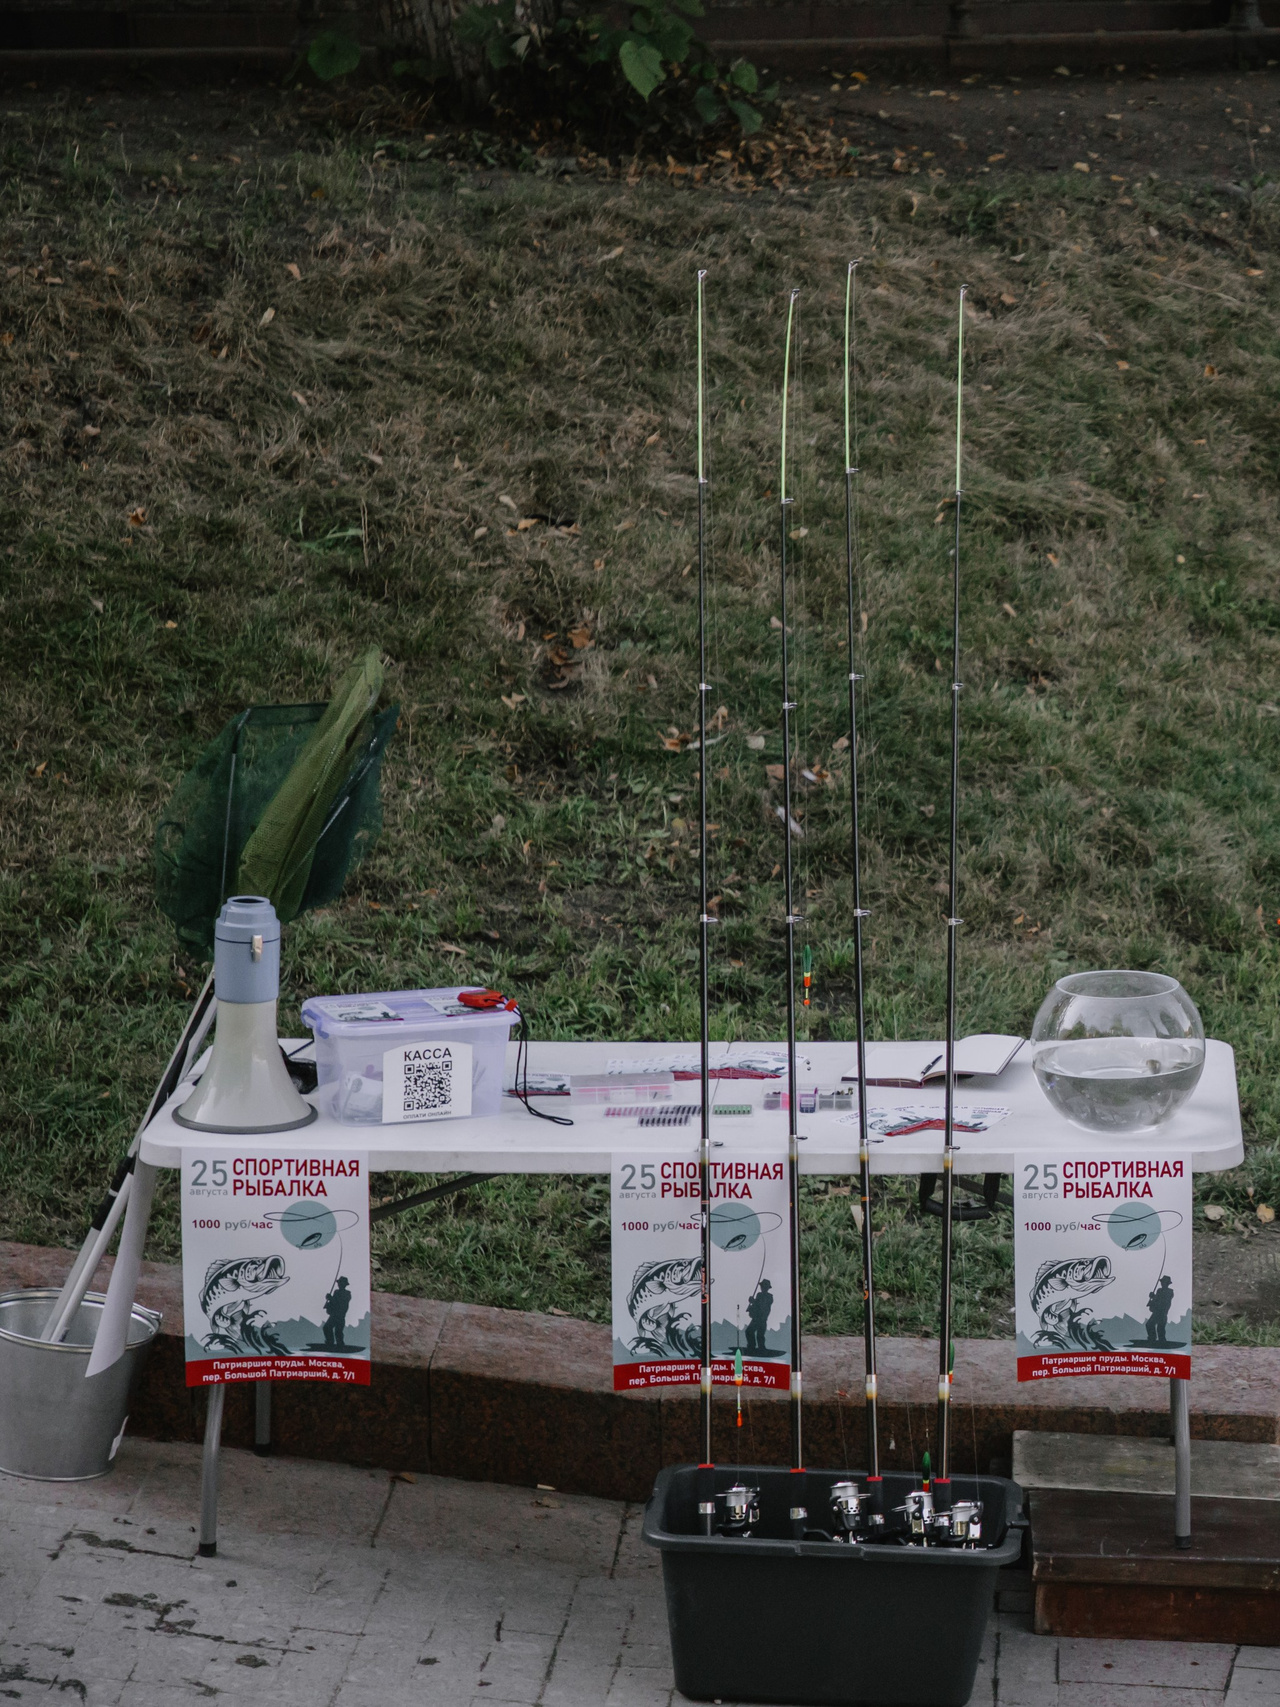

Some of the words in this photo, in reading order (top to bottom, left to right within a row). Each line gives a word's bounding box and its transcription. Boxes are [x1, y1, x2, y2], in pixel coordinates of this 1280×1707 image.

[404, 1047, 452, 1061] КАССА
[191, 1160, 228, 1186] 25
[232, 1158, 359, 1177] СПОРТИВНАЯ
[661, 1162, 783, 1180] СПОТИВНАЯ
[1063, 1160, 1183, 1179] СПОРТИВНАЯ
[620, 1164, 656, 1190] 25
[1024, 1164, 1058, 1190] 25
[190, 1188, 228, 1197] августа
[233, 1179, 328, 1197] РЫБАЛКА
[661, 1182, 752, 1199] РЫБЛКА
[1063, 1181, 1153, 1199] РЫБАЛКА
[619, 1192, 656, 1200] августа
[1022, 1191, 1059, 1200] августа
[192, 1219, 220, 1229] 1000
[621, 1222, 649, 1231] 1000
[1024, 1222, 1051, 1231] 1000
[213, 1359, 272, 1370] Патриаршие
[274, 1360, 306, 1369] пруды.
[309, 1359, 345, 1369] Москва,
[1042, 1355, 1096, 1365] Патриаршие
[1099, 1355, 1129, 1364] пруды.
[1132, 1355, 1166, 1364] Москва,
[639, 1363, 695, 1373] Патриаршие
[731, 1363, 766, 1373] Мсква,
[1032, 1369, 1050, 1377] пер.
[1052, 1365, 1092, 1375] Большой
[1094, 1364, 1151, 1374] Патриарший,
[1165, 1366, 1176, 1375] 7/1
[202, 1373, 222, 1382] пер.
[224, 1370, 267, 1380] Большой
[270, 1370, 330, 1379] Патриарший,
[332, 1372, 340, 1380] д.
[343, 1371, 355, 1380] 7/1
[629, 1378, 647, 1386] пер.
[650, 1374, 690, 1383] Большой
[764, 1376, 775, 1385] 7/1
